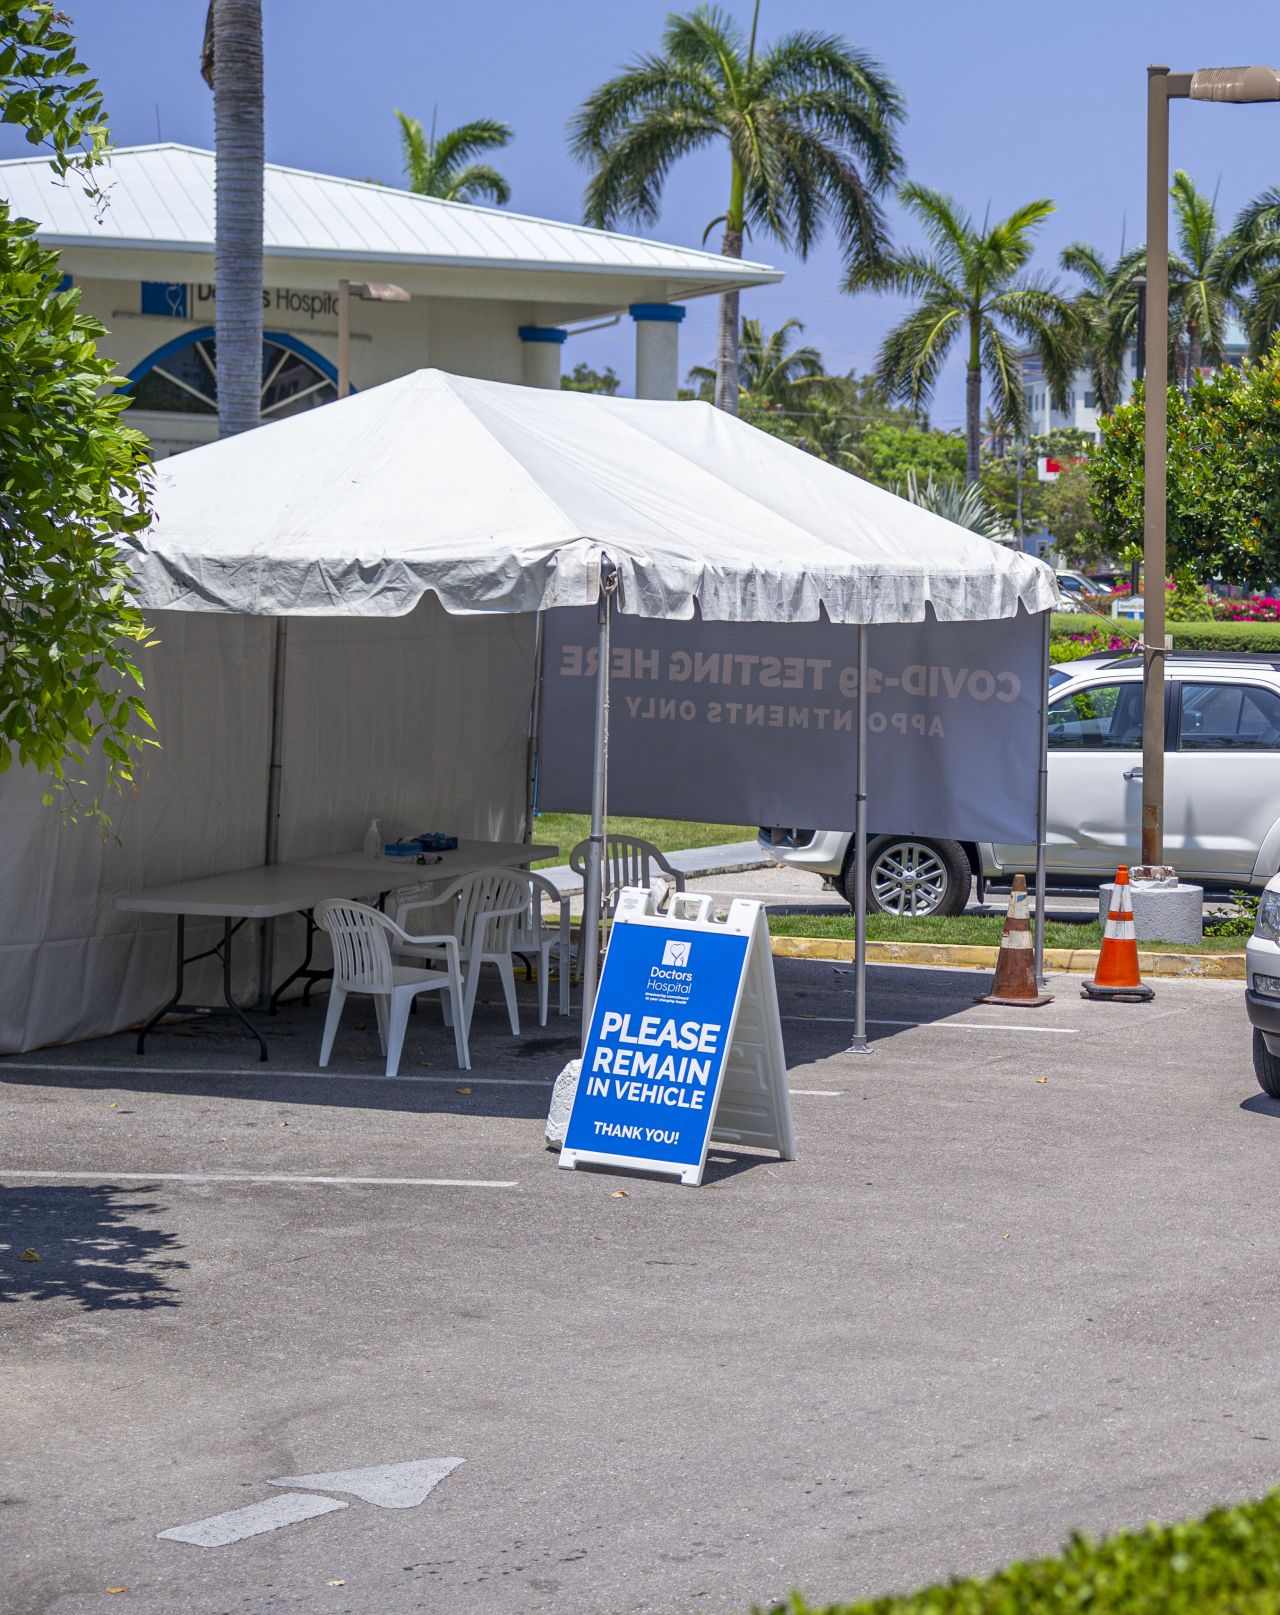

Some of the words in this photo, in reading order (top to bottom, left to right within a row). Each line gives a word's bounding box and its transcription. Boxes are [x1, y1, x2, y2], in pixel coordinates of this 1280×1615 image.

[276, 288, 339, 320] Hospit
[647, 979, 692, 994] Hospital
[650, 966, 692, 982] Doctors
[600, 1011, 721, 1054] PLEASE
[592, 1046, 712, 1086] REMAIN
[586, 1076, 611, 1098] IN
[615, 1080, 706, 1110] VEHICLE
[594, 1121, 643, 1140] THANK
[645, 1128, 680, 1145] YOU!
